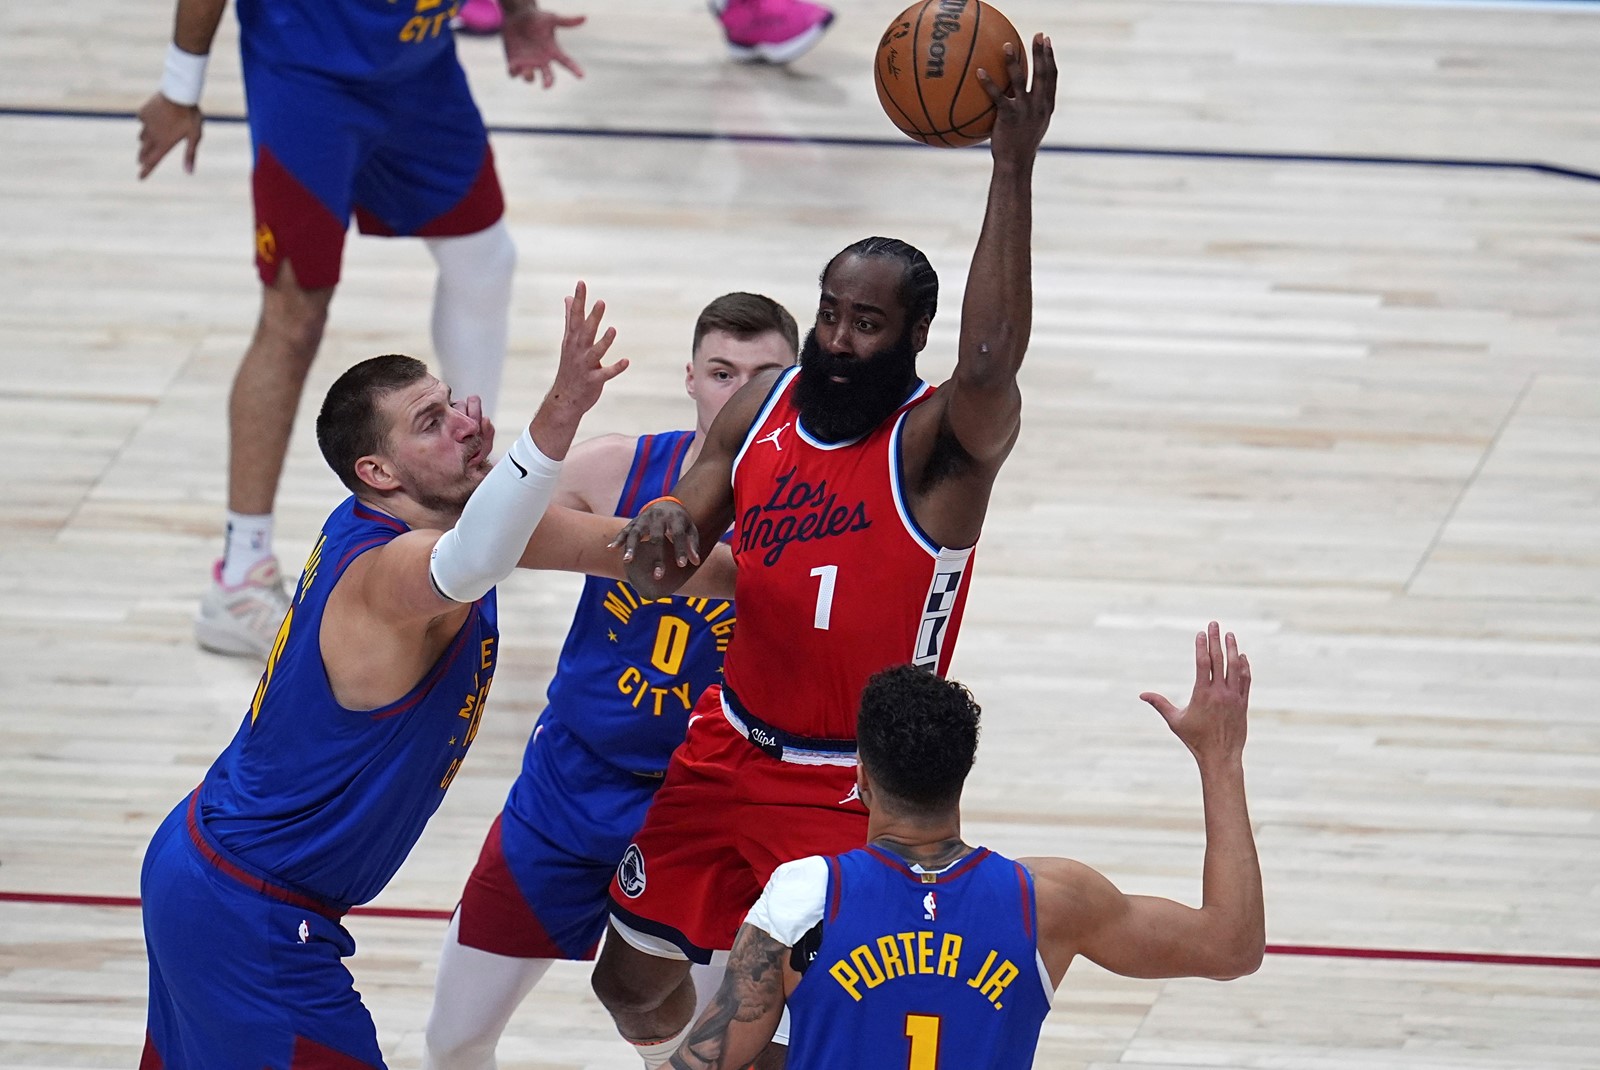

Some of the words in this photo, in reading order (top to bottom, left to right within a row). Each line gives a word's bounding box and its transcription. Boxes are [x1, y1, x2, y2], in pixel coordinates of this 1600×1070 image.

[764, 465, 827, 512] Los
[735, 494, 873, 567] Angeles
[603, 581, 672, 625] MI
[810, 565, 838, 630] 1
[651, 615, 690, 675] 0
[617, 666, 692, 716] CITY
[751, 728, 776, 746] Clips
[828, 931, 963, 1002] PORTER
[966, 949, 1020, 1010] JR.
[905, 1013, 940, 1070] 1
